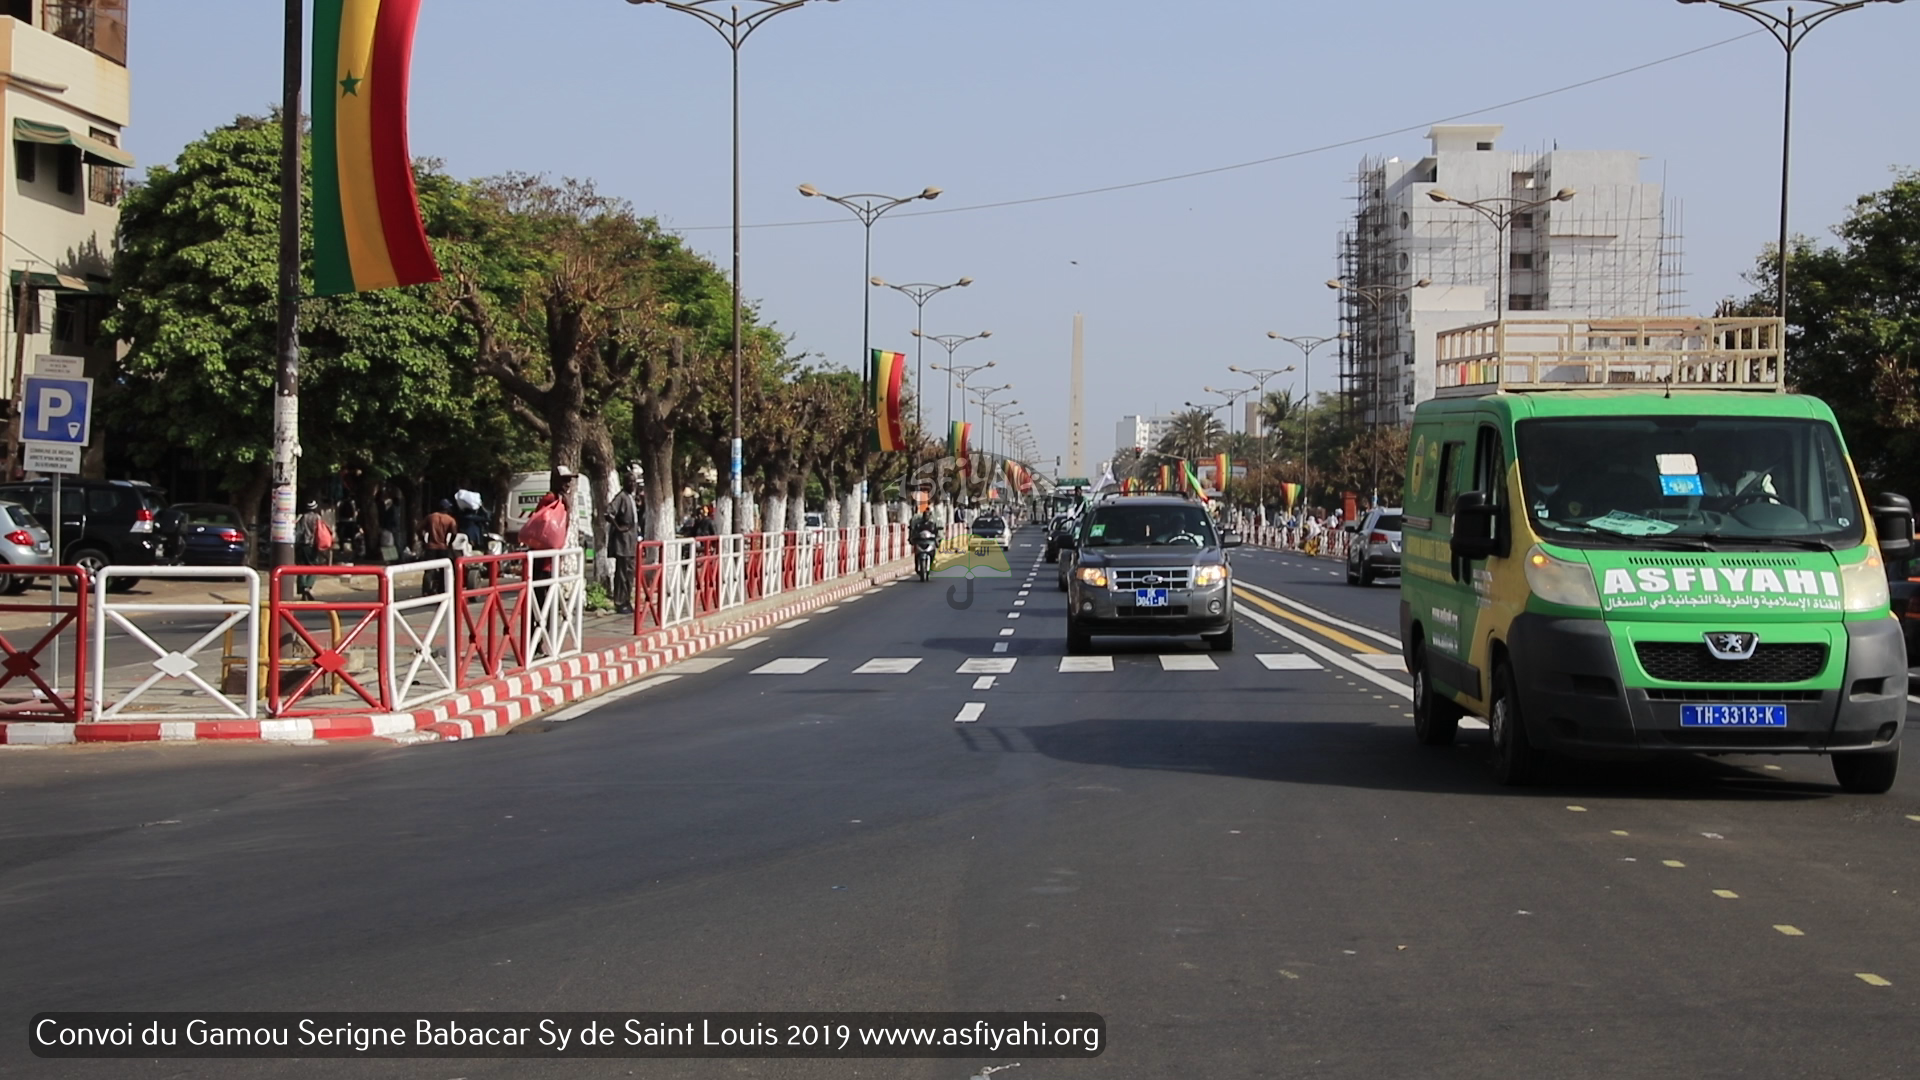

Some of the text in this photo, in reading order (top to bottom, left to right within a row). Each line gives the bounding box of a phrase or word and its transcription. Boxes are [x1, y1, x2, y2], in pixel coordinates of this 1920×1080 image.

[38, 387, 72, 432] P
[1603, 568, 1839, 596] ASFIYAHI
[1604, 595, 1646, 612] السنغال
[1649, 596, 1665, 610] في
[1714, 595, 1760, 608] والطريقة
[1813, 599, 1842, 611] القناة
[1695, 706, 1774, 724] TH-3313-K
